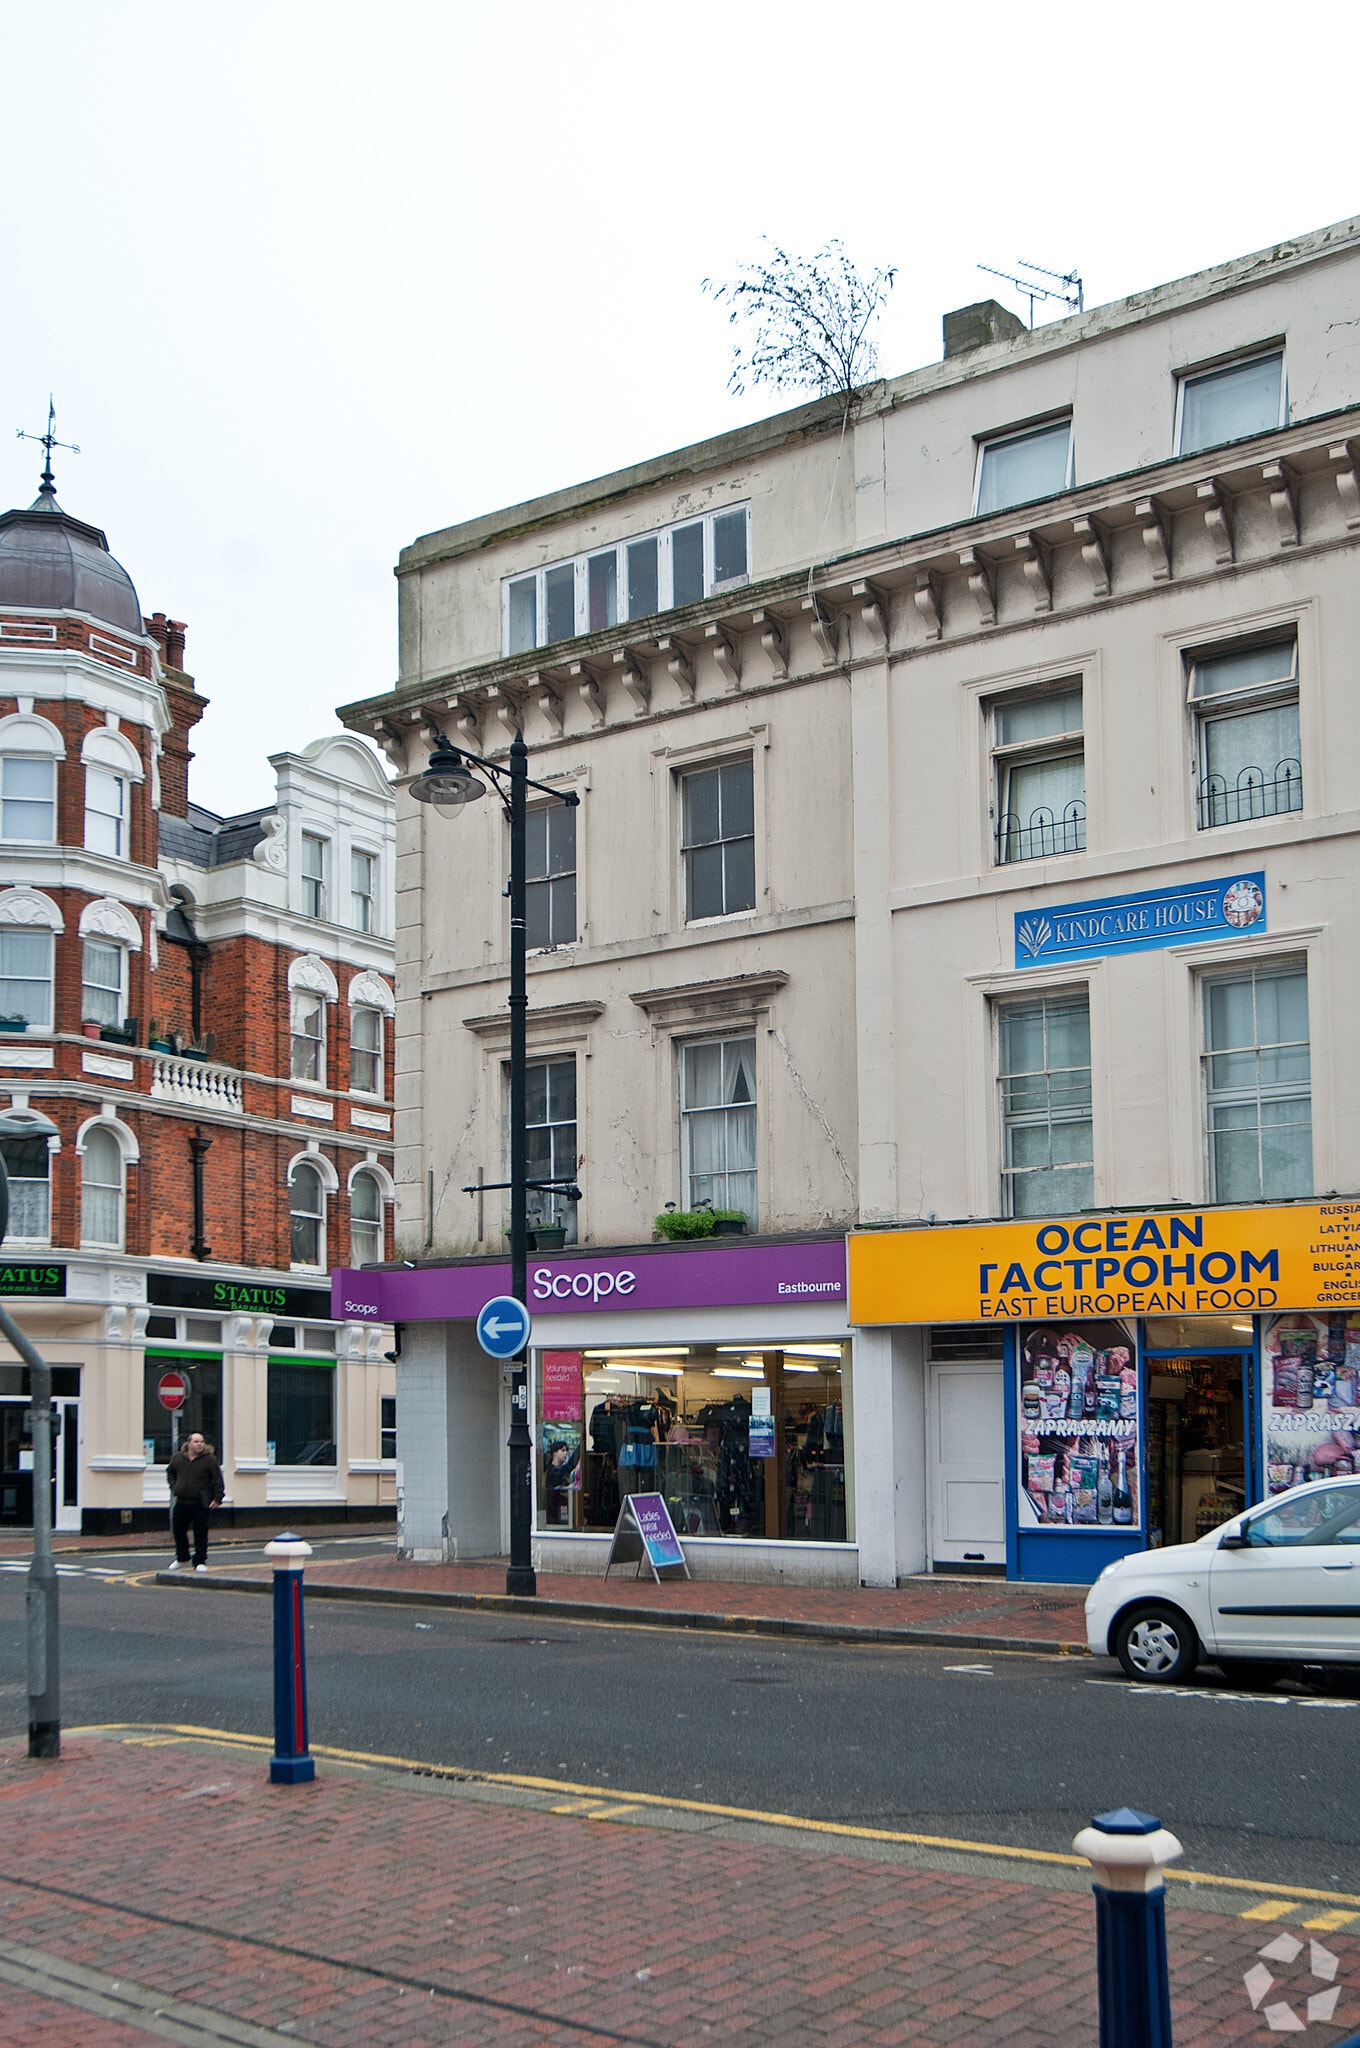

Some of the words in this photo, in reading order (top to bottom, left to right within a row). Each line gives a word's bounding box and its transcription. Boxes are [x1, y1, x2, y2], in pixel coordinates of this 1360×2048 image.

[1055, 909, 1149, 943] KINDCARE
[1154, 898, 1218, 928] HOUSE
[1036, 1215, 1203, 1256] OCEAN
[0, 1267, 60, 1285] ATUS
[979, 1248, 1279, 1294] ГАСТРОНОМ
[213, 1282, 287, 1306] STATUS
[532, 1267, 636, 1303] Scope
[777, 1281, 842, 1295] Eastbourne
[344, 1300, 379, 1316] Scope
[980, 1297, 1038, 1318] EAST
[1046, 1291, 1186, 1315] EUROPEAN
[1196, 1287, 1278, 1310] FOOD
[545, 1363, 578, 1373] Volunteers
[545, 1373, 570, 1382] needed
[1025, 1419, 1136, 1437] ZAPRASZAMY
[638, 1511, 661, 1523] Ladies
[643, 1522, 659, 1532] wear
[646, 1530, 672, 1541] needed
